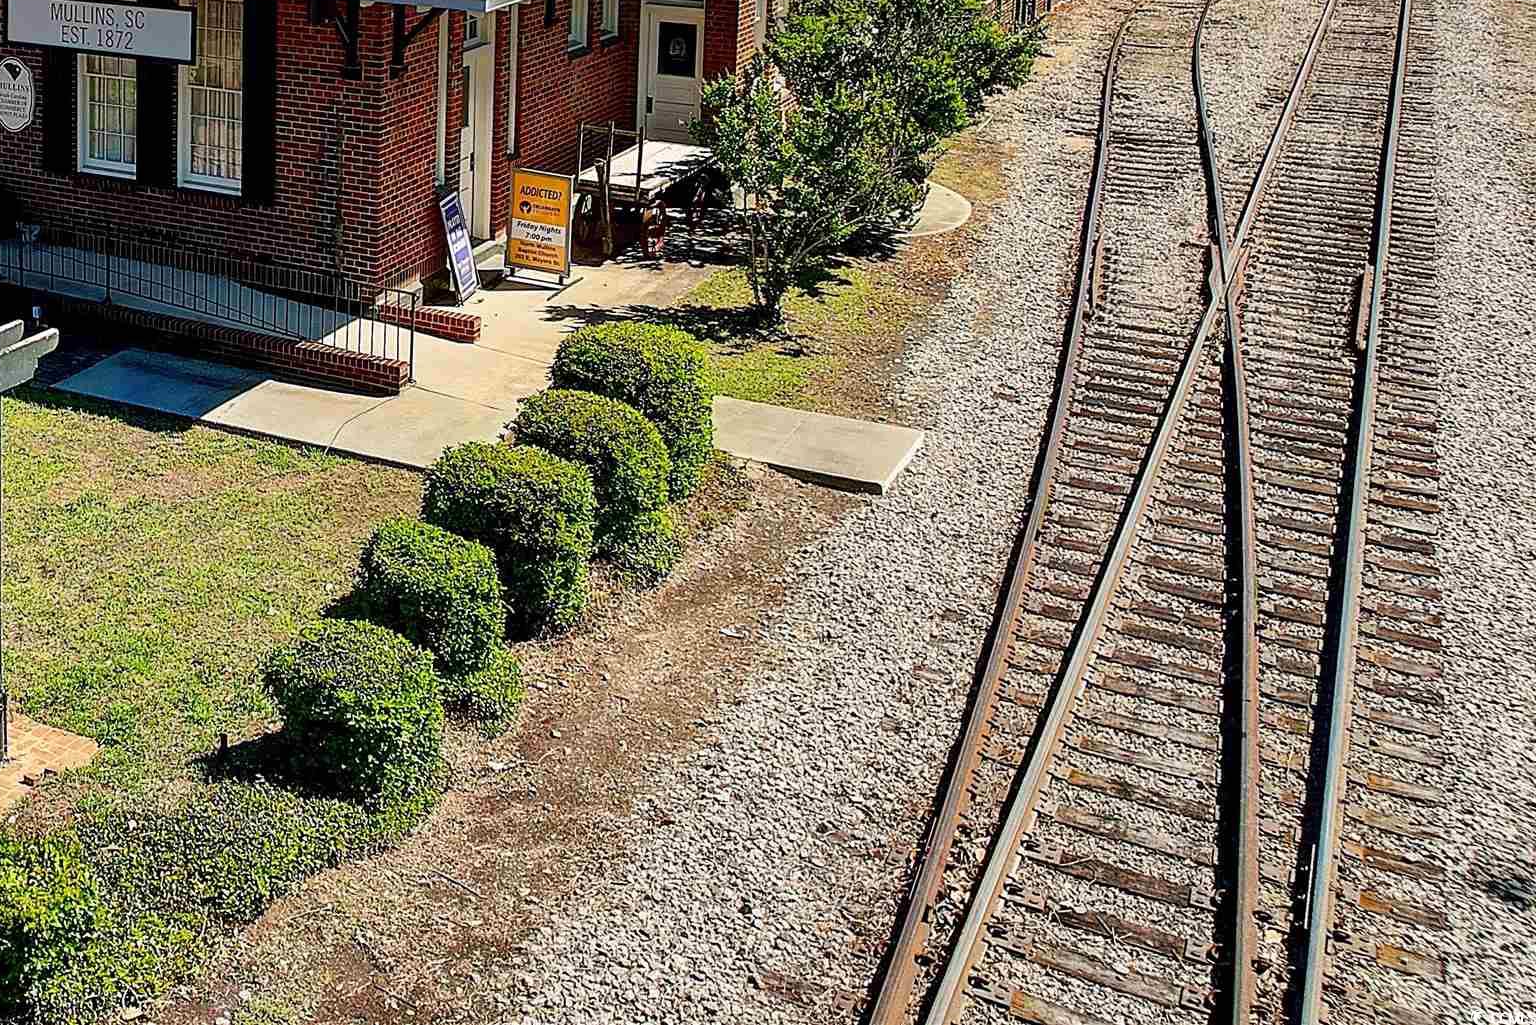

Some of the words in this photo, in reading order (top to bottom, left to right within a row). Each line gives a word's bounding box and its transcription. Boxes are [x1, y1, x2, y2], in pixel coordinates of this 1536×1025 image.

[50, 2, 119, 28] MULLINS,
[125, 9, 145, 29] SC
[61, 26, 91, 46] EST.
[97, 29, 134, 50] 1872
[520, 185, 562, 201] ADDICTED?
[517, 220, 539, 232] Friday
[539, 225, 561, 235] Nights
